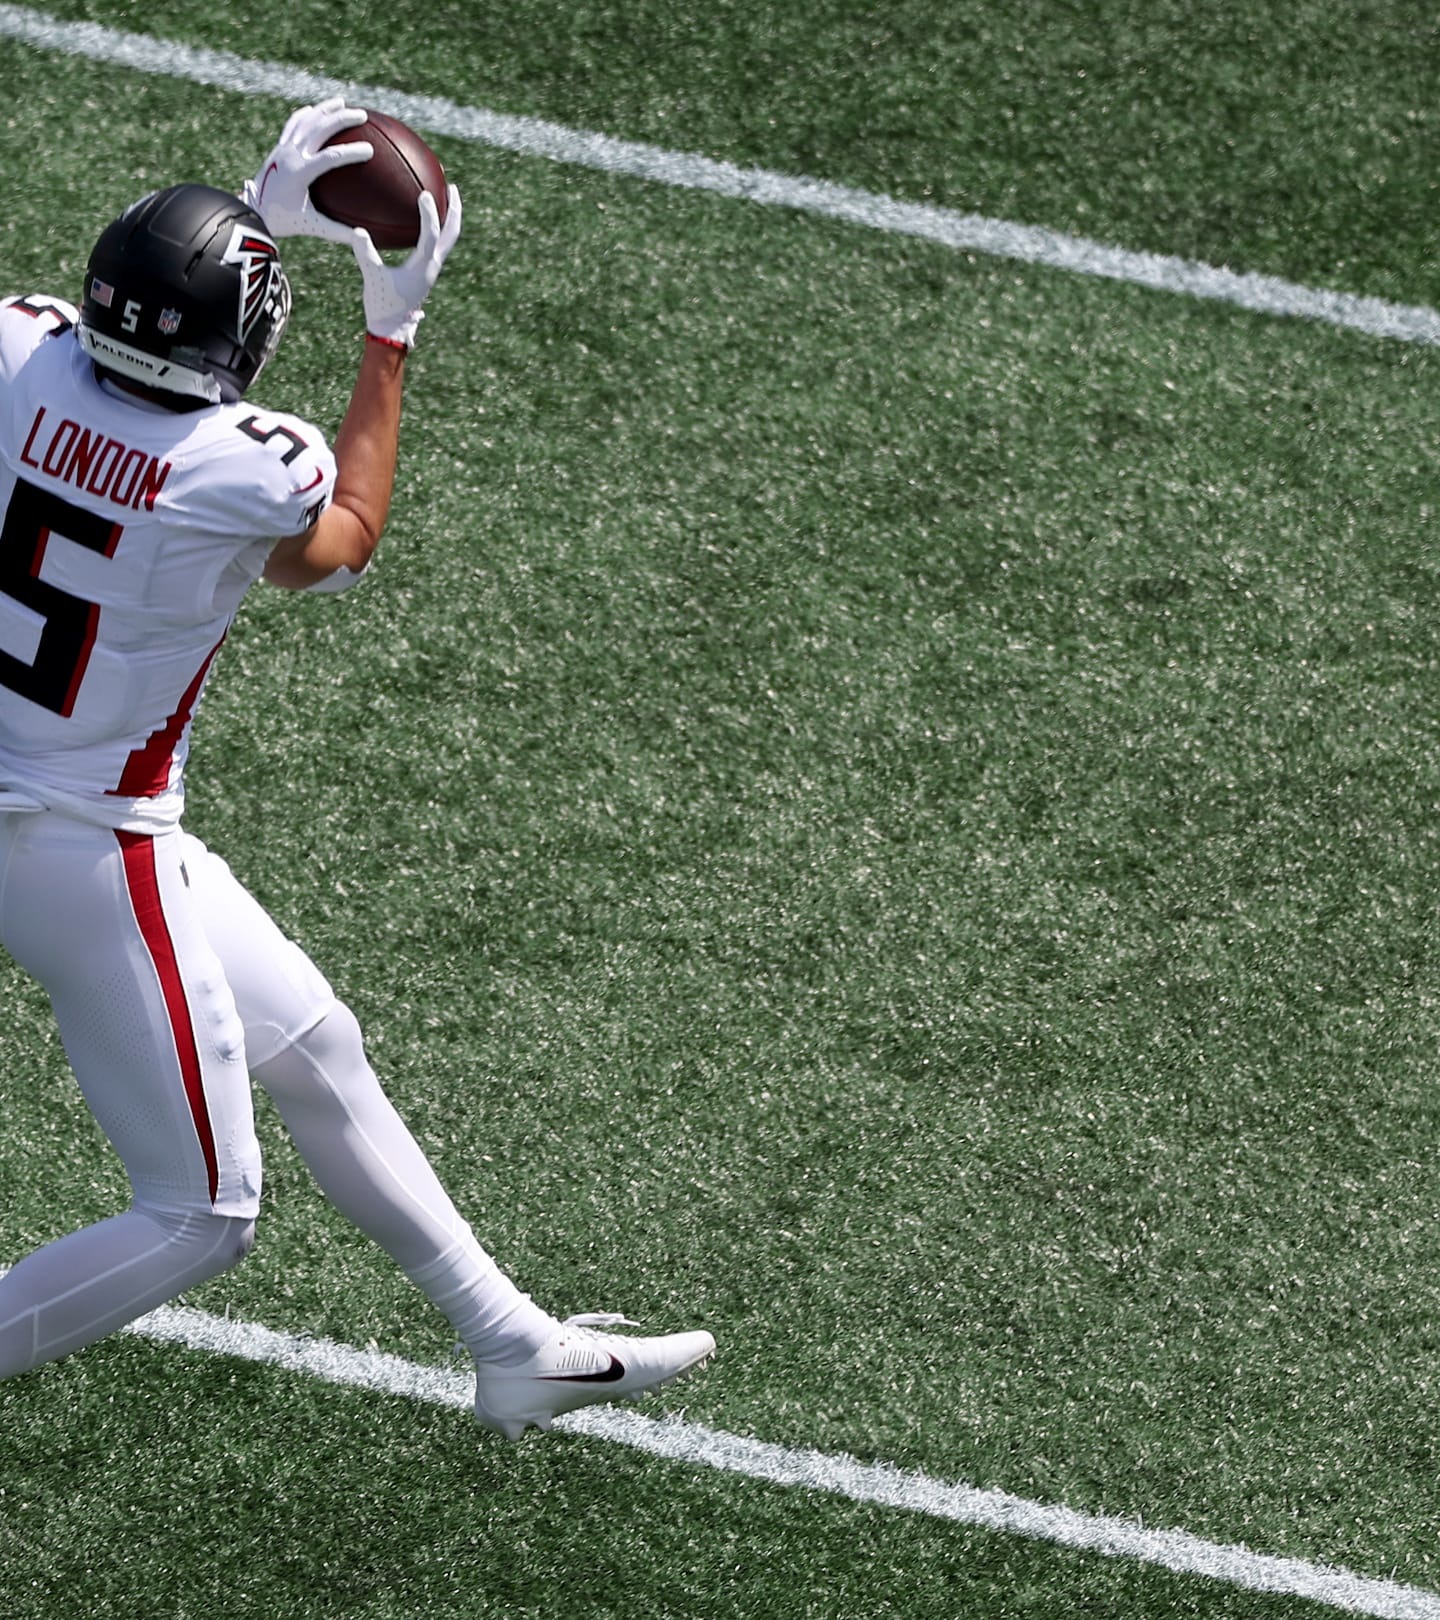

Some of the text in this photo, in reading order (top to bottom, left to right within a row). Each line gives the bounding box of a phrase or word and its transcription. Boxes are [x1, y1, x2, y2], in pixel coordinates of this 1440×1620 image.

[121, 299, 142, 333] 5
[93, 339, 154, 371] FALCONS
[20, 405, 173, 513] LONDON
[235, 414, 309, 468] 5
